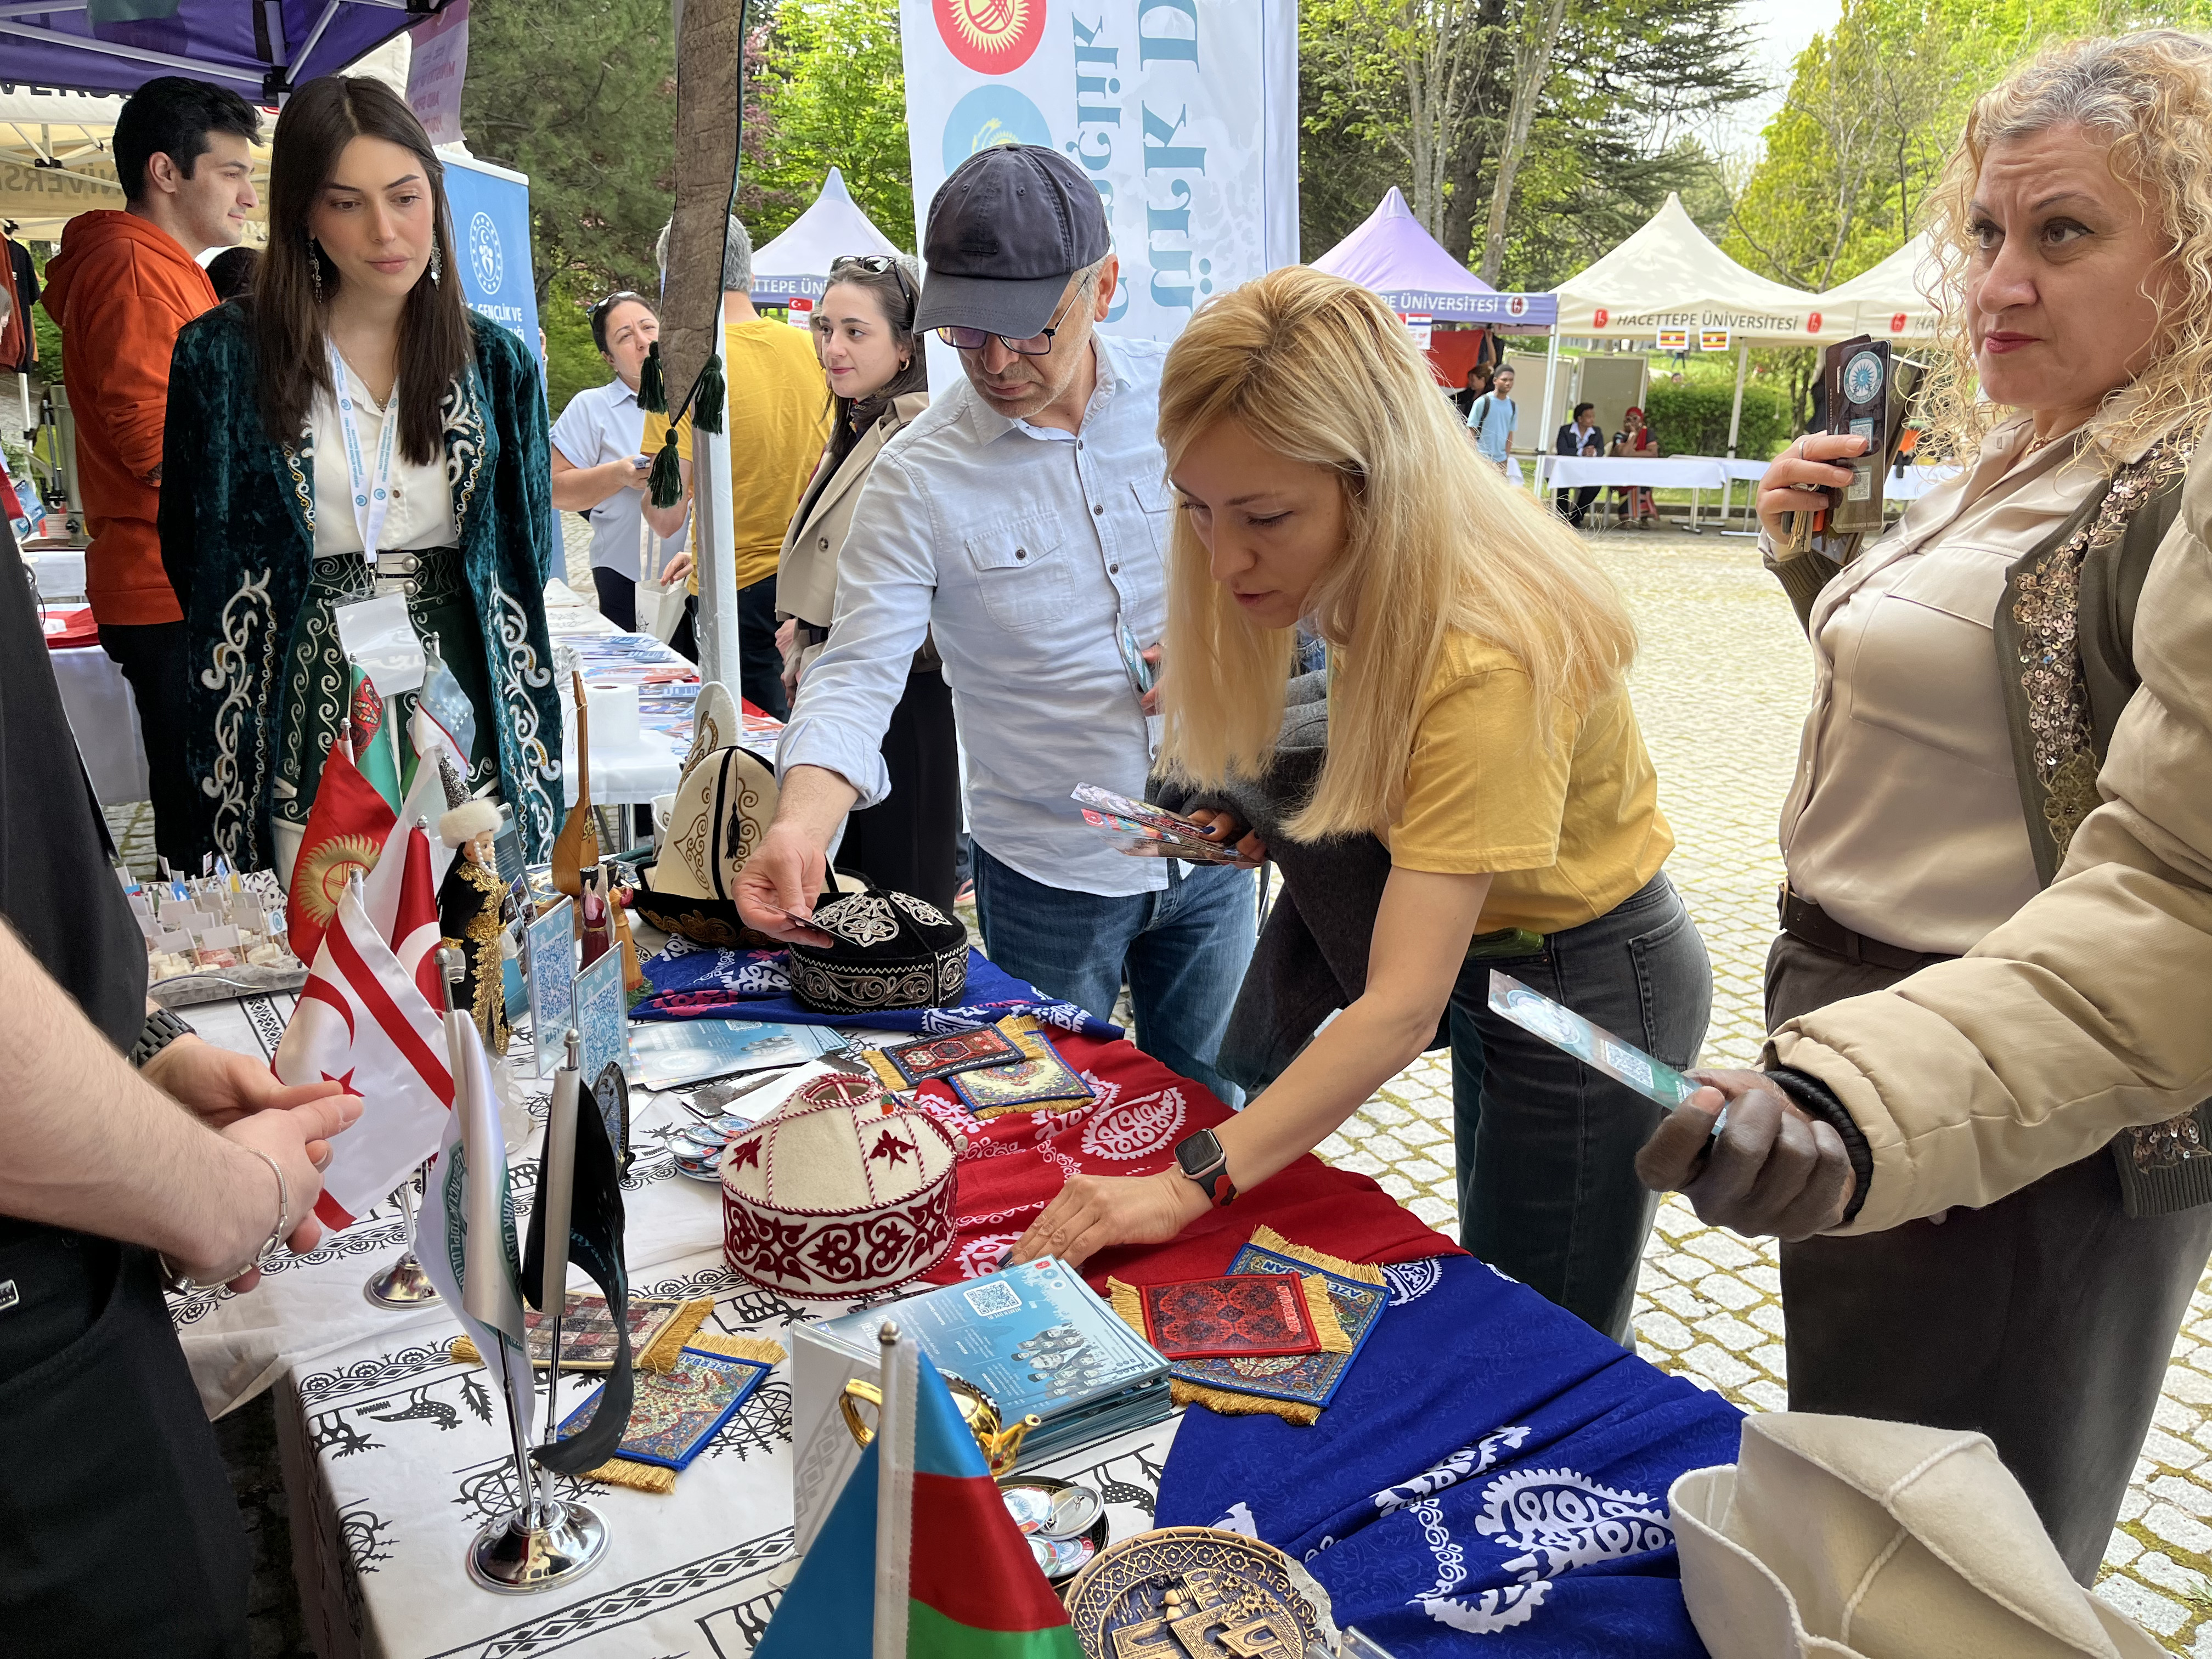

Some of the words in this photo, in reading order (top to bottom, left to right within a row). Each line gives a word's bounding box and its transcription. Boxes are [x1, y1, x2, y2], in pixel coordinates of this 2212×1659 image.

[751, 279, 797, 293] TTEPE
[1400, 293, 1499, 312] ÜNİVERSİTESİ
[511, 307, 523, 321] VE
[1617, 313, 1696, 326] HACETTEPE
[1702, 311, 1799, 331] ÜNİVERSİTESİ
[568, 1228, 608, 1272] nyası
[676, 1353, 735, 1372] AZERBAI
